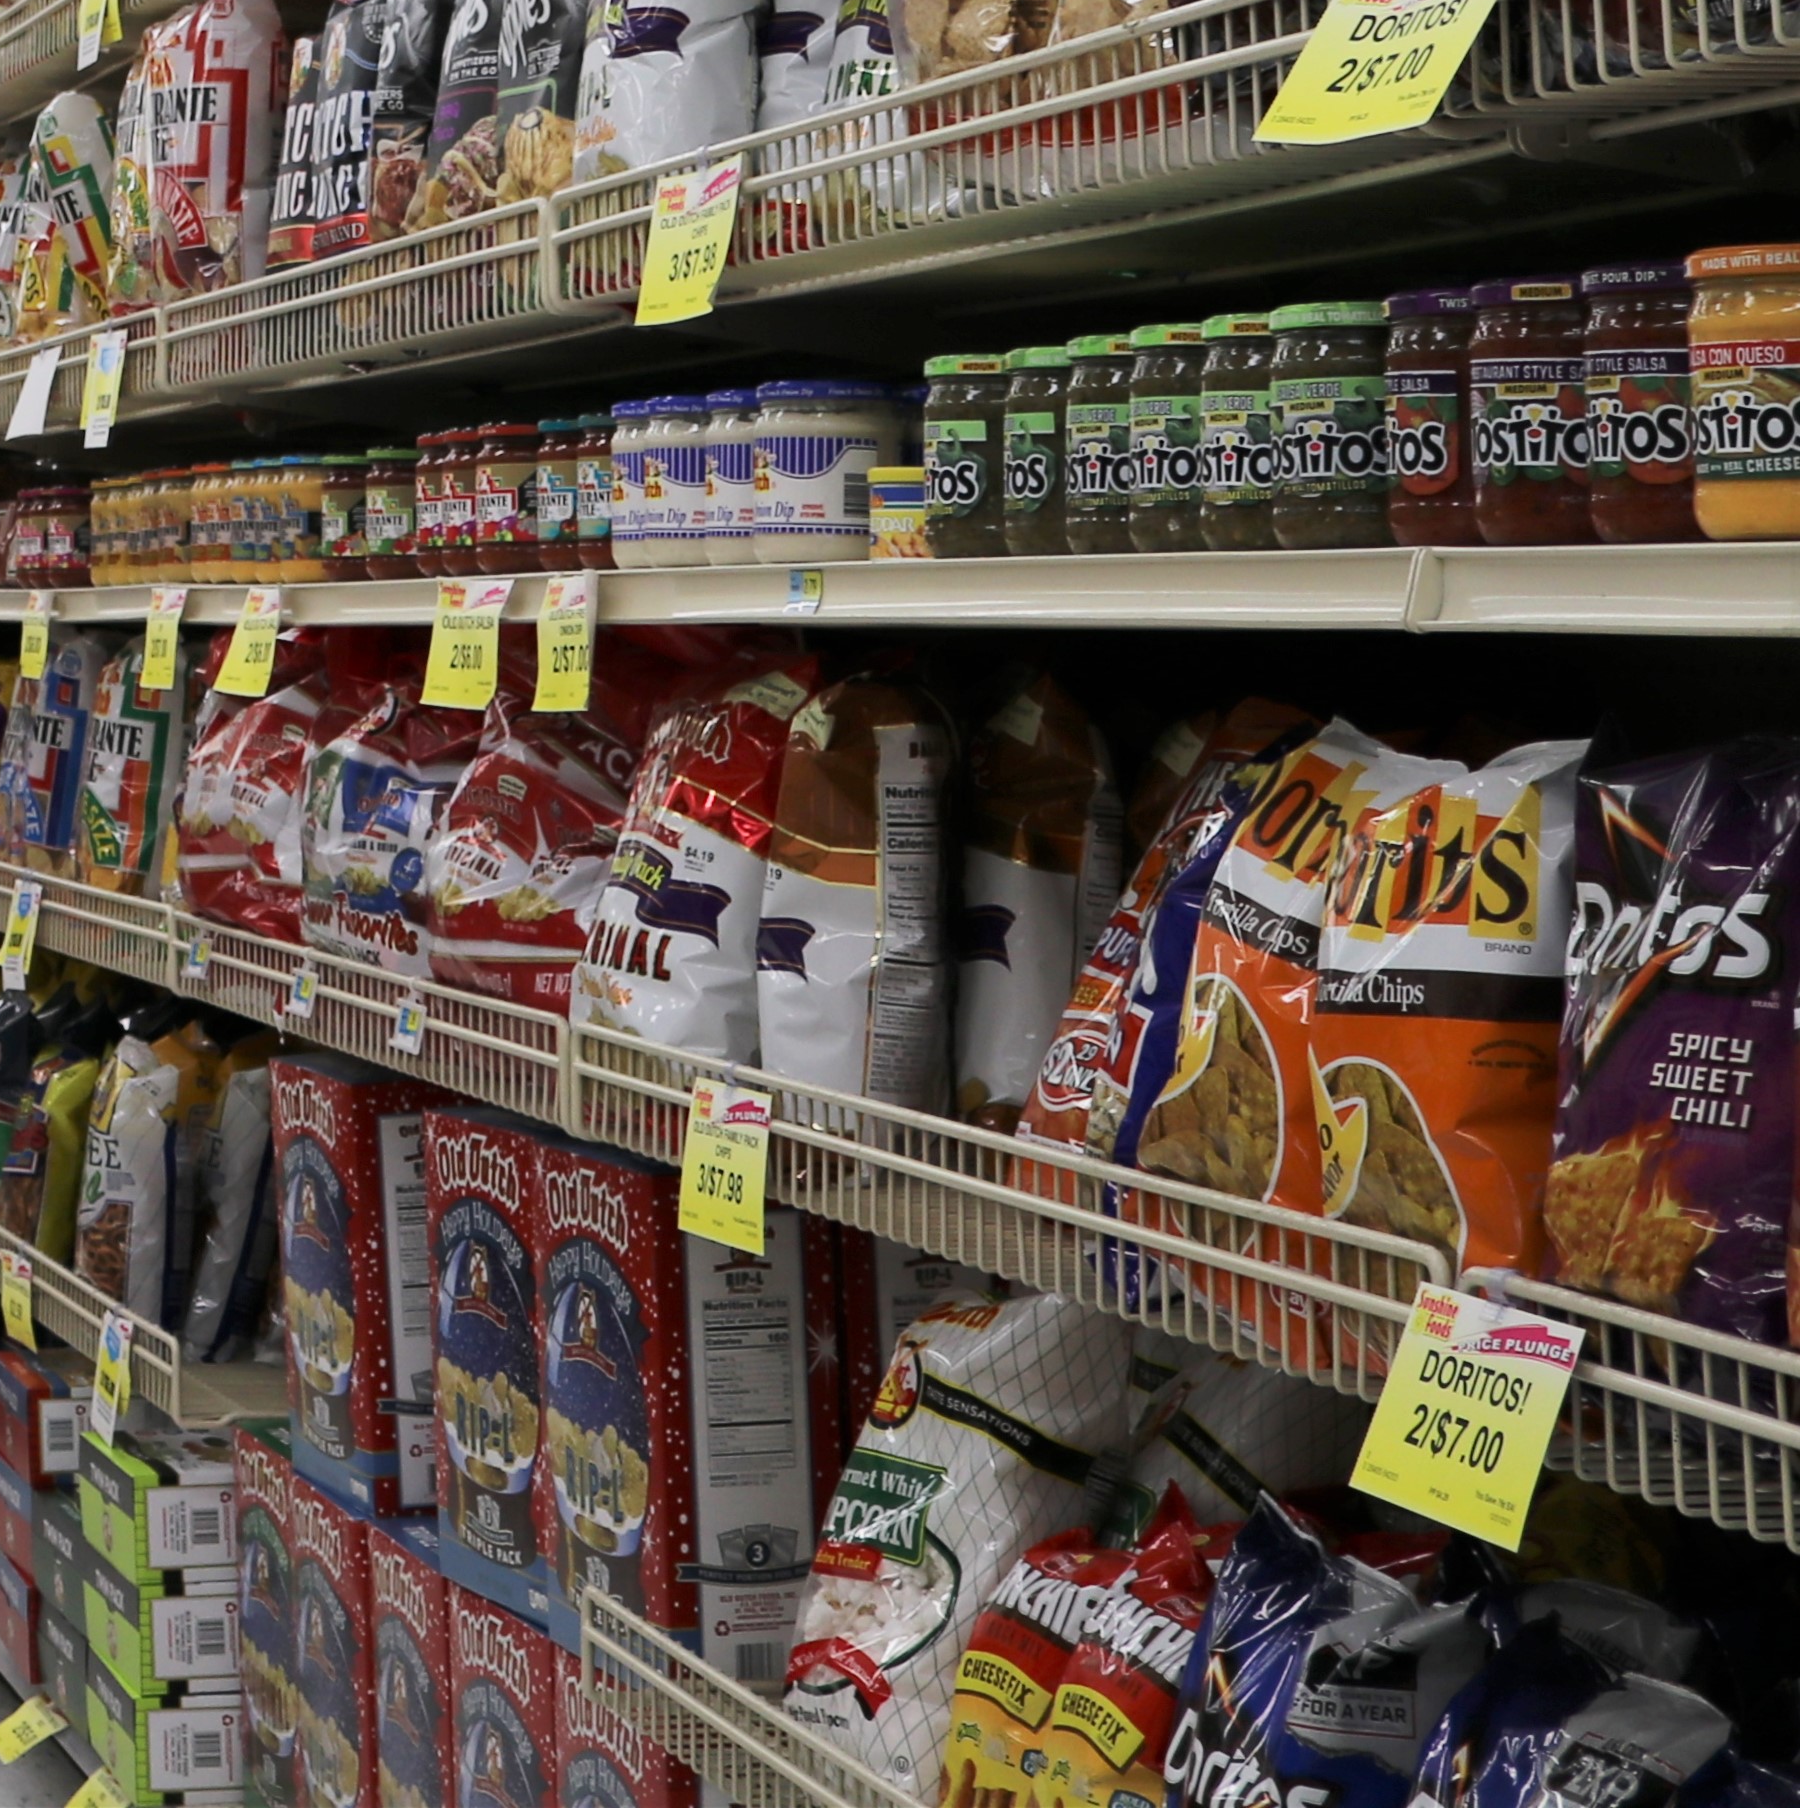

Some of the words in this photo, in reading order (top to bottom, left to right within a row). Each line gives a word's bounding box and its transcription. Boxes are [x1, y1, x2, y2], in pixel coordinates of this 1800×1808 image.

[1326, 44, 1434, 95] 2/$7.00
[669, 242, 718, 282] 3/$7.98
[1730, 253, 1762, 268] WITH
[1765, 250, 1800, 265] REAL
[1519, 287, 1563, 297] MEDIUM
[1628, 356, 1668, 372] SALSA
[1710, 348, 1733, 365] CON
[1735, 346, 1784, 366] QUESO
[960, 363, 996, 372] MEDIUM
[1523, 364, 1560, 380] STYLE
[1703, 368, 1743, 380] MEDIUM
[1307, 382, 1341, 398] VERDE
[1401, 378, 1430, 392] SALSA
[1504, 383, 1546, 394] MEDIUM
[1288, 401, 1326, 412] MEDIUM
[1747, 457, 1799, 473] CHEESE
[775, 501, 795, 523] Dip
[685, 846, 714, 863] $4.19
[1485, 943, 1531, 955] BRAND
[1366, 977, 1425, 1006] Chips
[1669, 1032, 1752, 1063] SPICY
[1650, 1063, 1753, 1095] SWEET
[1670, 1097, 1751, 1128] CHILI
[697, 1164, 742, 1205] 3/$7.98
[1417, 1290, 1458, 1319] Sunshine
[1424, 1317, 1452, 1339] Foods
[1457, 1338, 1501, 1352] PRICE
[1505, 1339, 1571, 1362] PLUNGE
[1419, 1349, 1532, 1416] DORITOS!
[947, 1396, 1032, 1447] SENSATIONS
[1405, 1404, 1504, 1473] 2/$7.00
[462, 1531, 497, 1557] TRIPLE
[500, 1544, 523, 1566] PACK
[838, 1553, 871, 1569] Tender
[1063, 1692, 1099, 1726] CHEESE
[1101, 1715, 1125, 1745] FIX
[1343, 1705, 1356, 1719] A
[1358, 1704, 1407, 1723] YEAR
